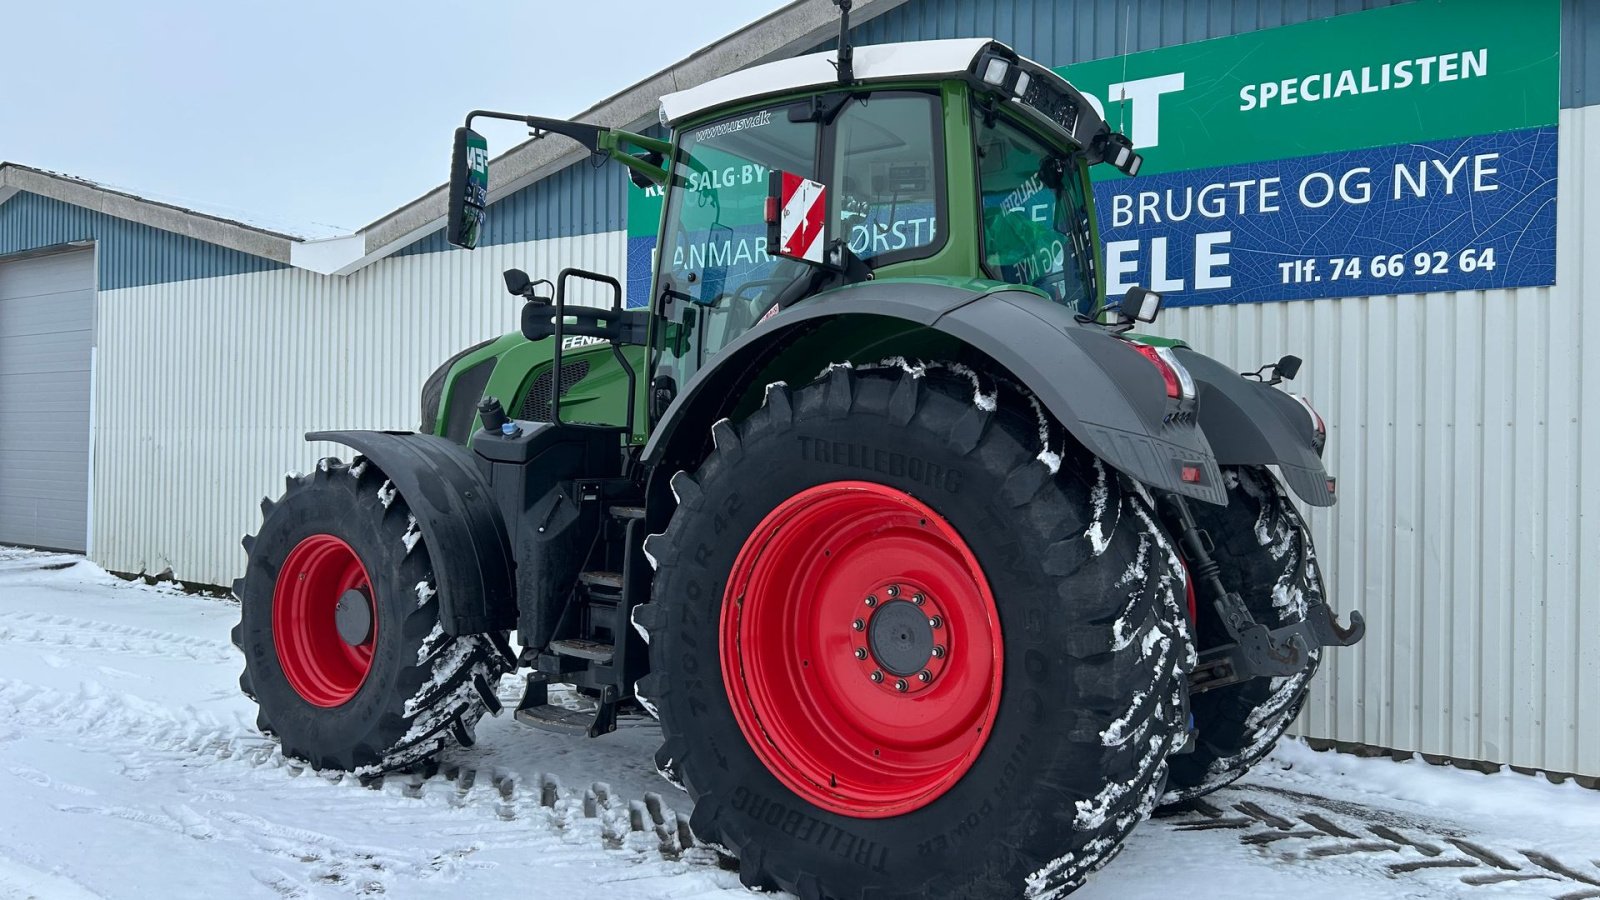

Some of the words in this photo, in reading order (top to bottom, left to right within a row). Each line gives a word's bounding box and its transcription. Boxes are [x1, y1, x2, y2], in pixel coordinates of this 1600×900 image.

[1082, 72, 1185, 150] T
[1240, 49, 1488, 112] SPECIALISTEN
[695, 110, 772, 143] www.usv.dk
[1112, 177, 1281, 227] BRUGTE
[1299, 167, 1371, 209] OG
[1394, 153, 1500, 201] NYE
[651, 236, 777, 273] ANMAR
[1279, 261, 1321, 284] Tlf.
[1329, 257, 1361, 281] 74
[1370, 254, 1404, 278] 66
[1414, 251, 1449, 275] 92
[1459, 248, 1496, 272] 64
[797, 435, 963, 497] TRELLEBORG
[712, 491, 744, 537] 42
[731, 785, 891, 876] TRELLEBORG
